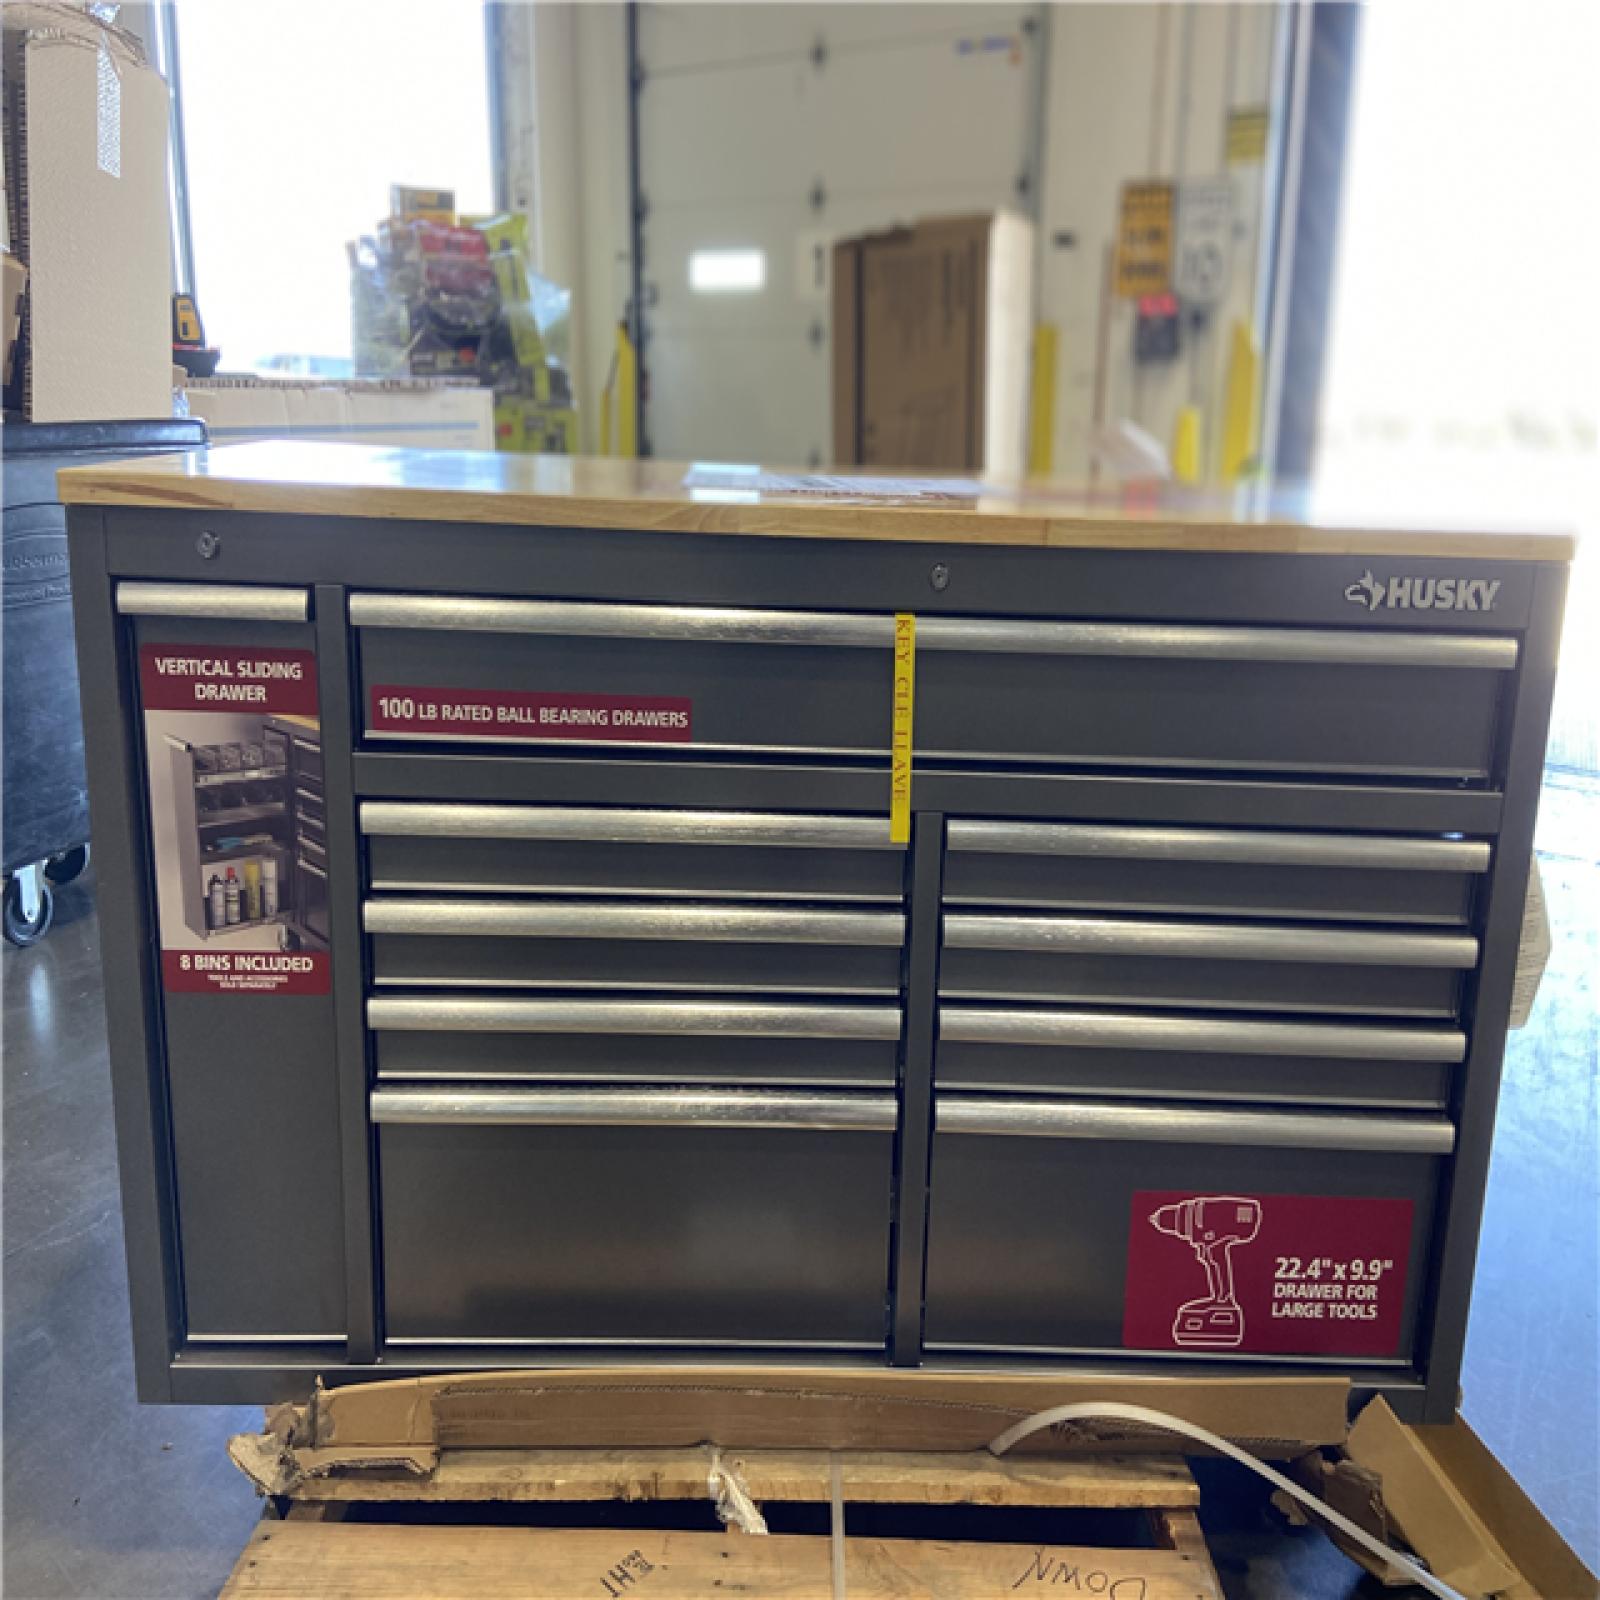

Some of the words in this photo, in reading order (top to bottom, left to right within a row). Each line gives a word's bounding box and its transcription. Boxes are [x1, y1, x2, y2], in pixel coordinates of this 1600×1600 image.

[1386, 576, 1501, 611] HUSKY
[896, 619, 911, 665] KEY
[154, 656, 234, 677] VERTICAL
[237, 659, 303, 680] SLIDING
[194, 683, 267, 702] DRAWER
[379, 697, 415, 720] 100
[419, 703, 438, 721] LB
[441, 704, 493, 722] RATED
[497, 706, 536, 724] BALL
[539, 706, 608, 726] BEARING
[611, 709, 689, 729] DRAWERS
[179, 954, 191, 971] 8
[194, 954, 231, 971] BINS
[234, 955, 314, 973] INCLUDED
[1274, 1256, 1332, 1279] 22.4"
[1332, 1263, 1347, 1281] x
[1349, 1259, 1394, 1281] 9.9"
[1274, 1282, 1343, 1299] DRAWER
[1346, 1284, 1378, 1301] FOR
[1271, 1302, 1325, 1319] LARGE
[1328, 1304, 1379, 1320] TOOLS
